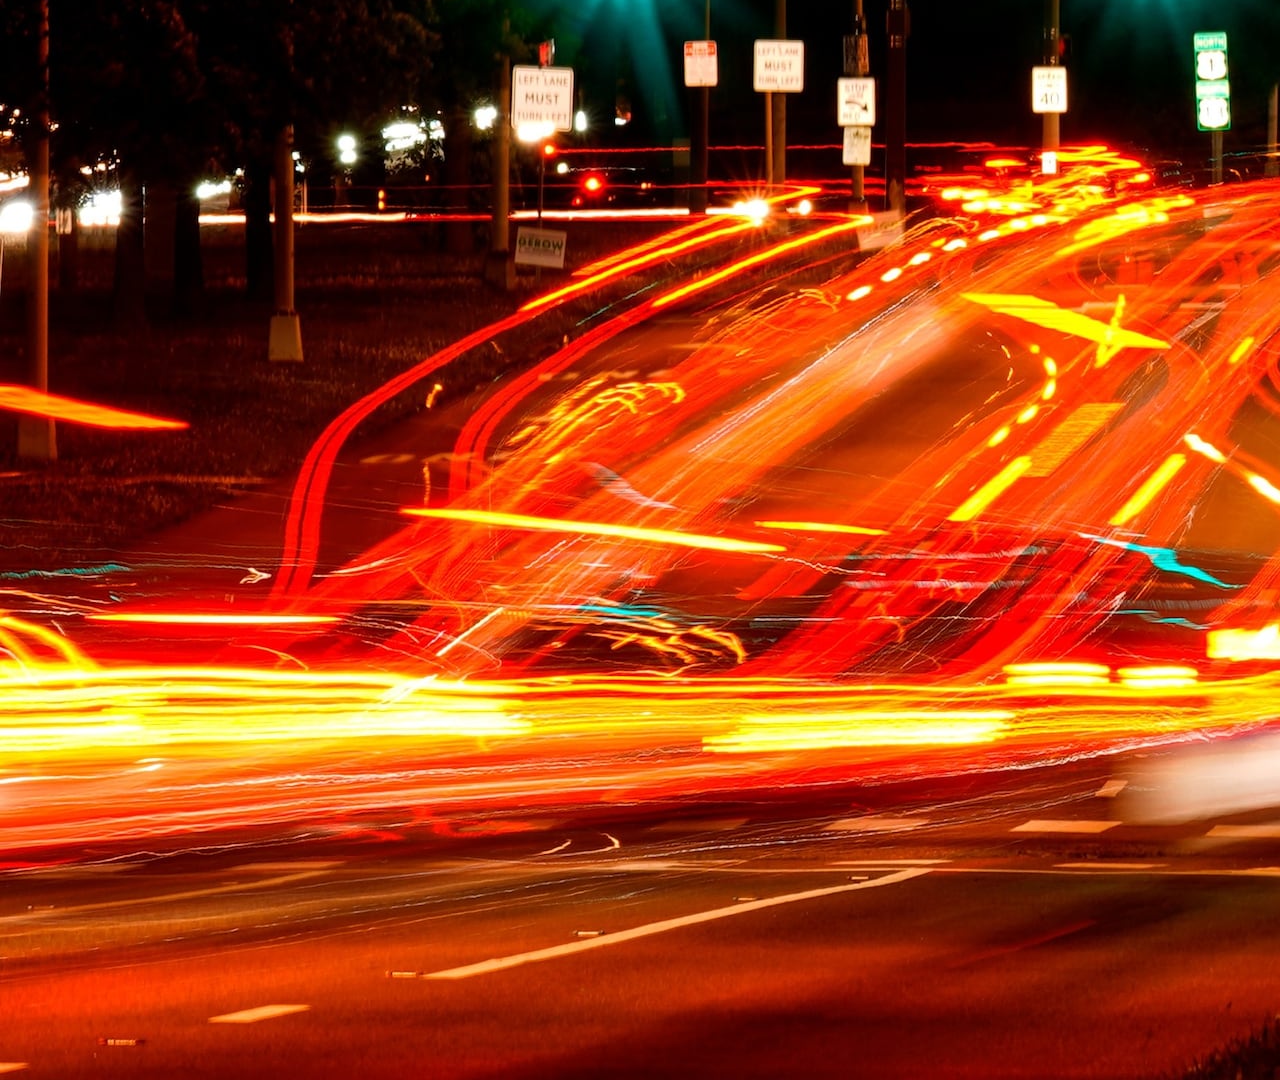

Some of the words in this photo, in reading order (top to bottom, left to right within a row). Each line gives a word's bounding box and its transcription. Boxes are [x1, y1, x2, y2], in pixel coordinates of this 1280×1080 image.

[757, 47, 776, 57] LEFT
[778, 47, 799, 57] LANE
[764, 62, 793, 71] MUST
[518, 75, 540, 86] LEFT
[544, 76, 569, 88] LANE
[525, 93, 559, 106] MUST
[1040, 92, 1060, 105] 40
